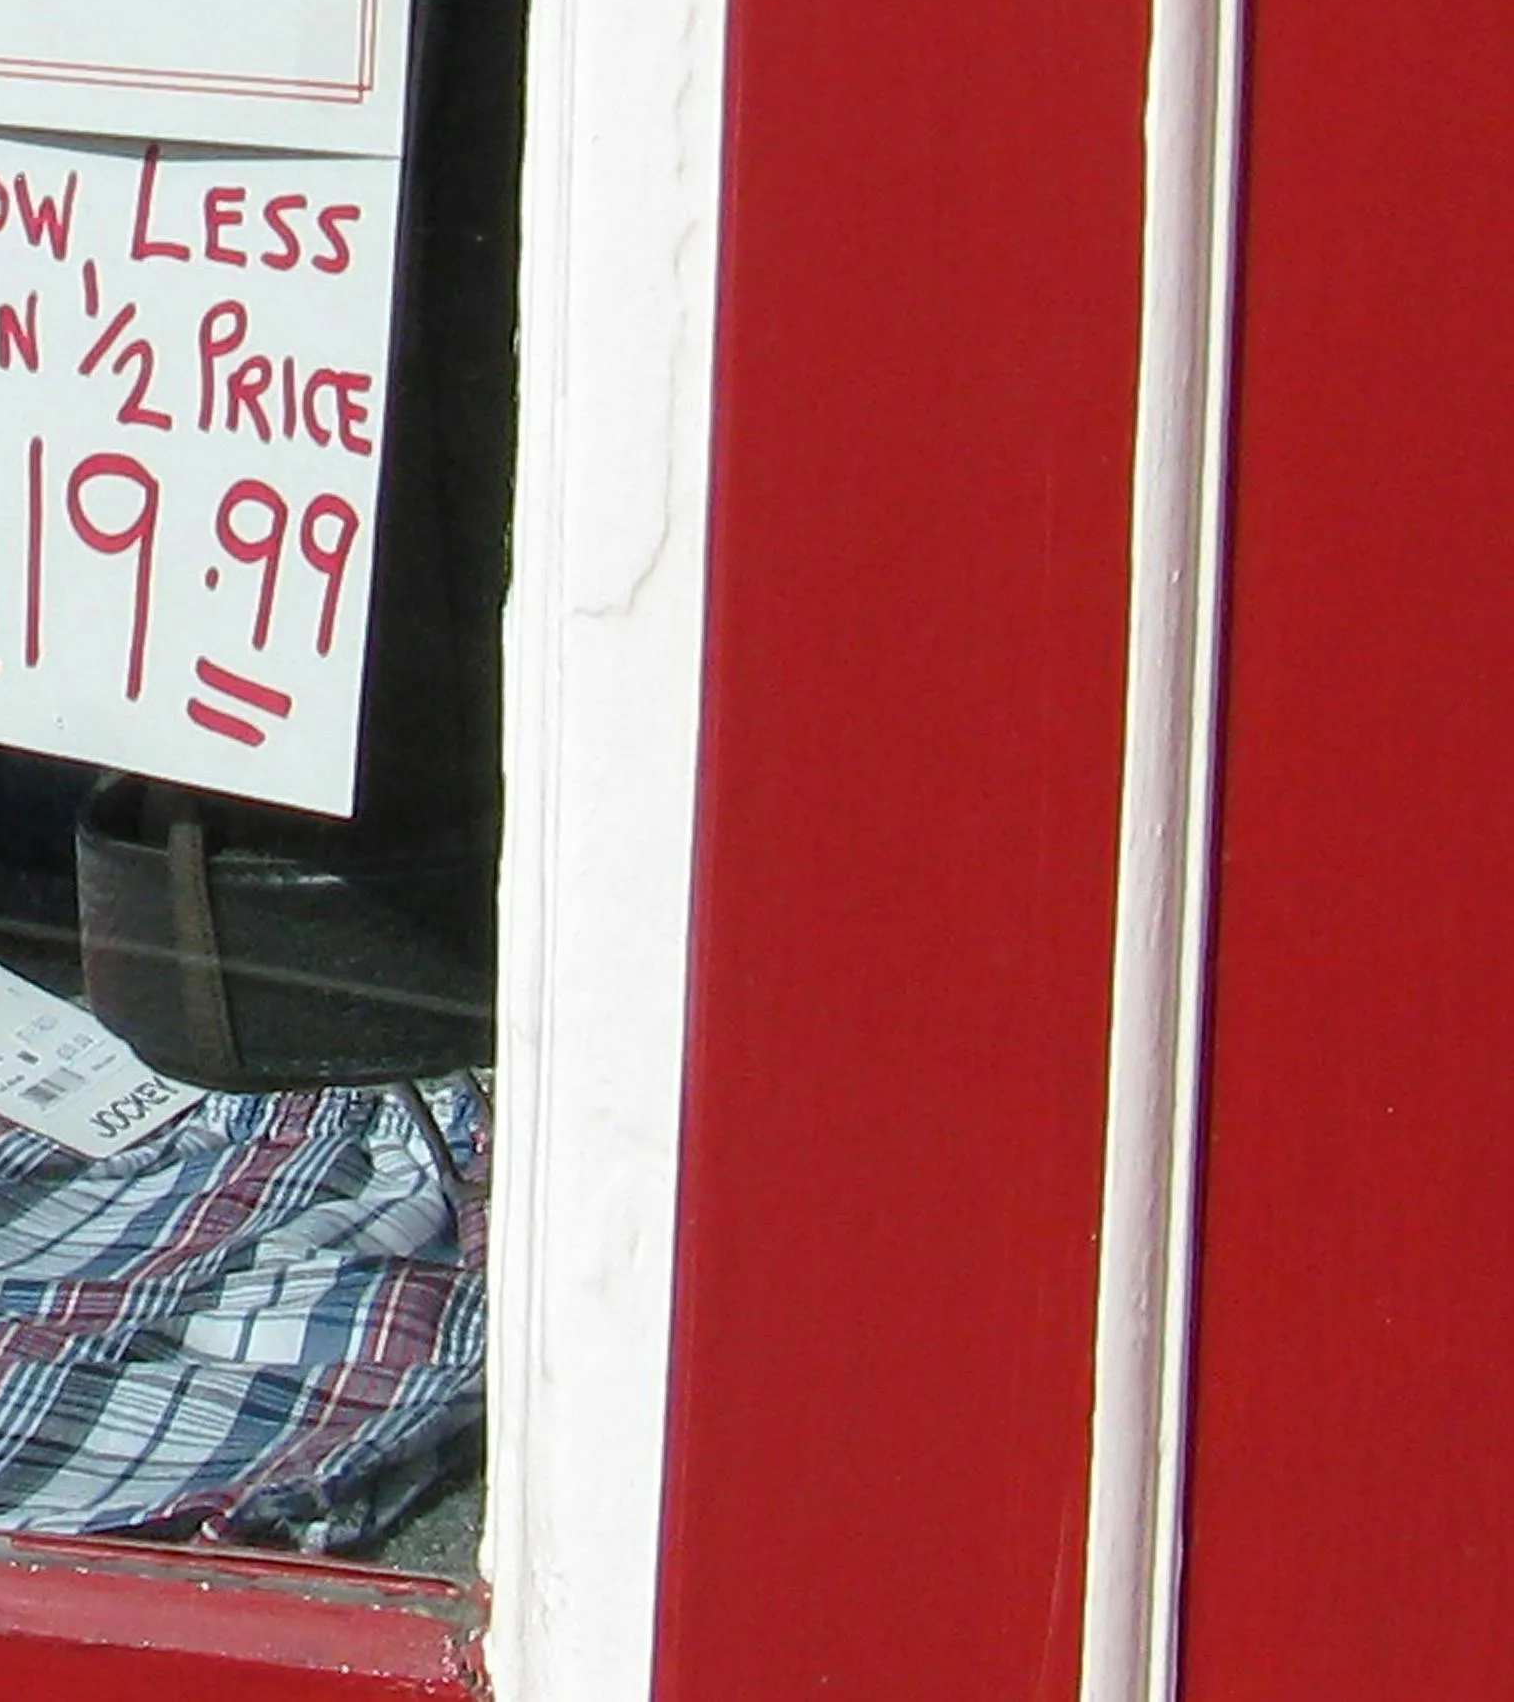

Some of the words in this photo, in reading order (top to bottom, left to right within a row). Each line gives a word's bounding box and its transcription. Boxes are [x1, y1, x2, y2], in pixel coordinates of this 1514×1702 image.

[130, 143, 362, 274] LESS
[198, 300, 373, 457] PRICE
[88, 1076, 180, 1139] JOCKEY
